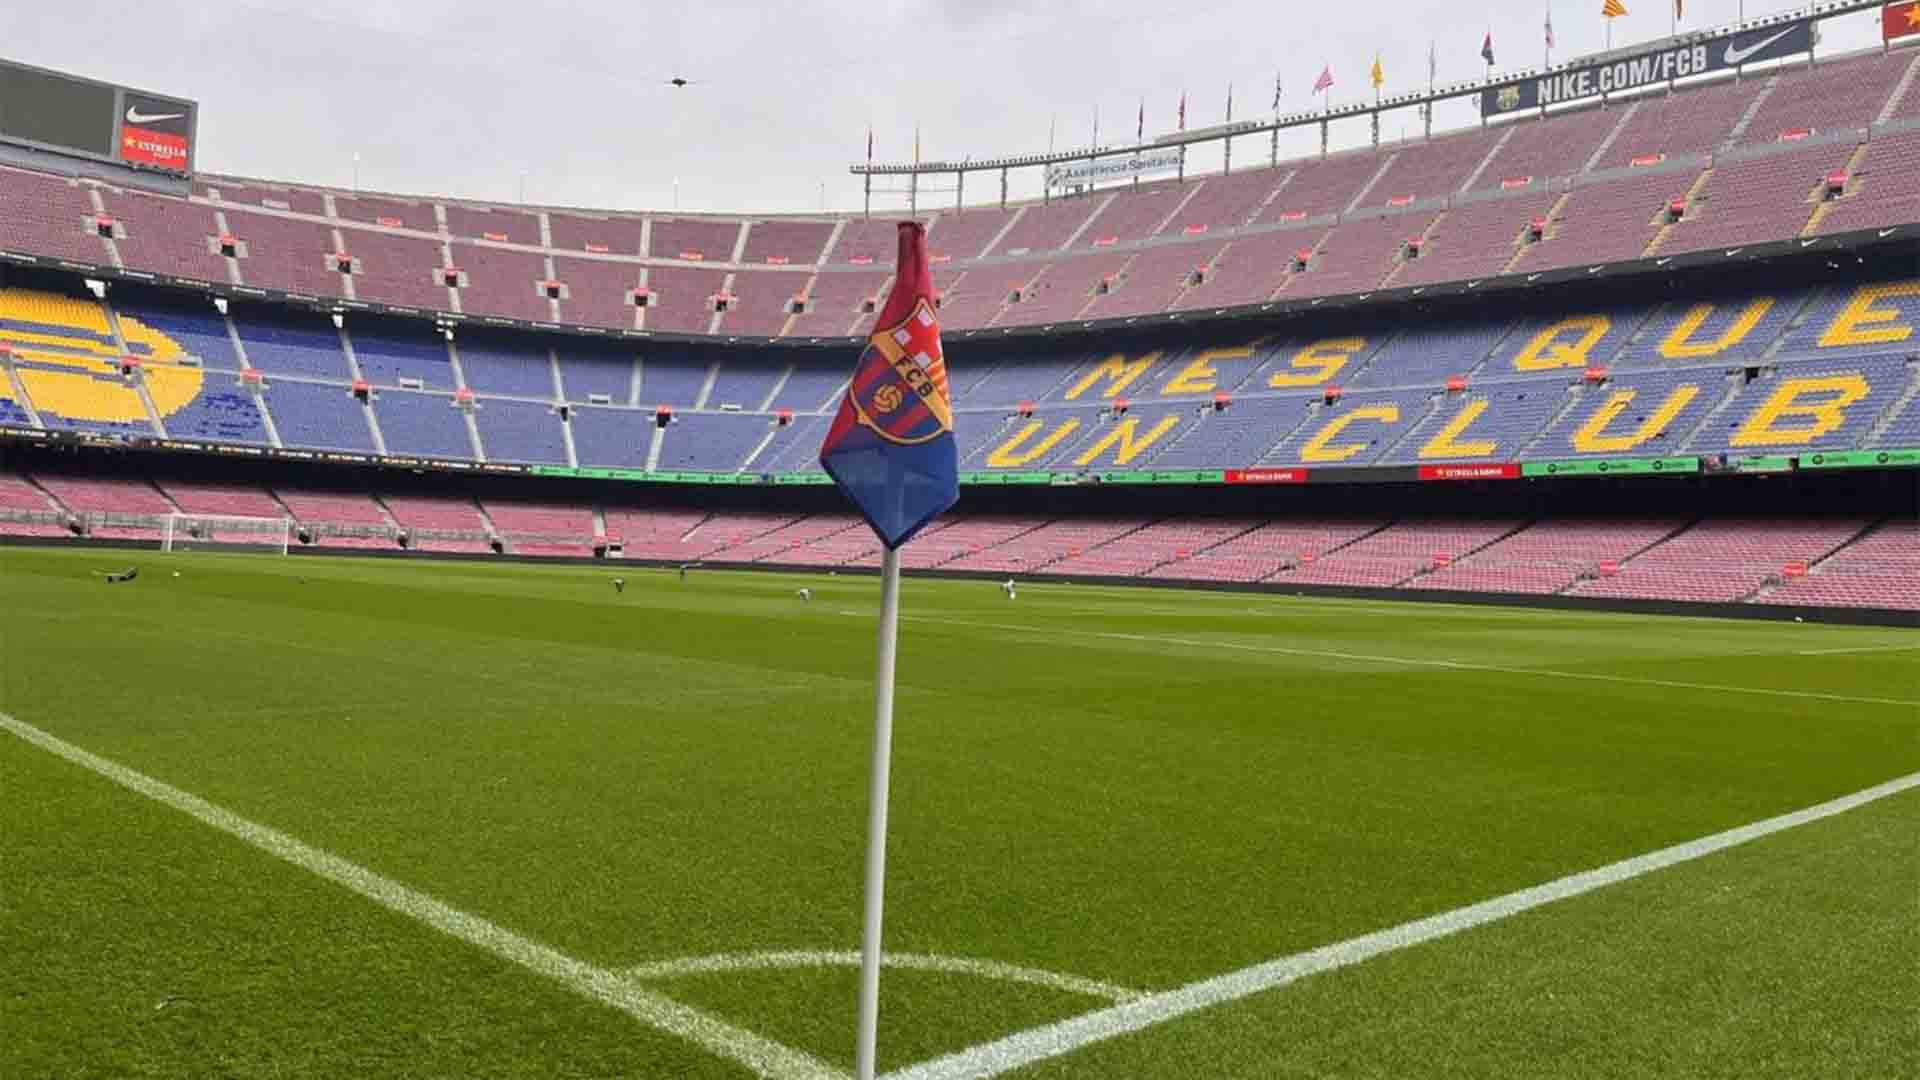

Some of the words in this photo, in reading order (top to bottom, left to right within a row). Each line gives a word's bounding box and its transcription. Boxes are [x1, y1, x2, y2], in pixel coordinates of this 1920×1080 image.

[1537, 46, 1707, 105] NIKE.COM/FCB
[137, 141, 186, 159] ESTRELLA
[1514, 282, 1920, 371] QUE
[895, 354, 933, 397] FCB
[987, 415, 1180, 467] UN
[1301, 374, 1871, 463] CLUB
